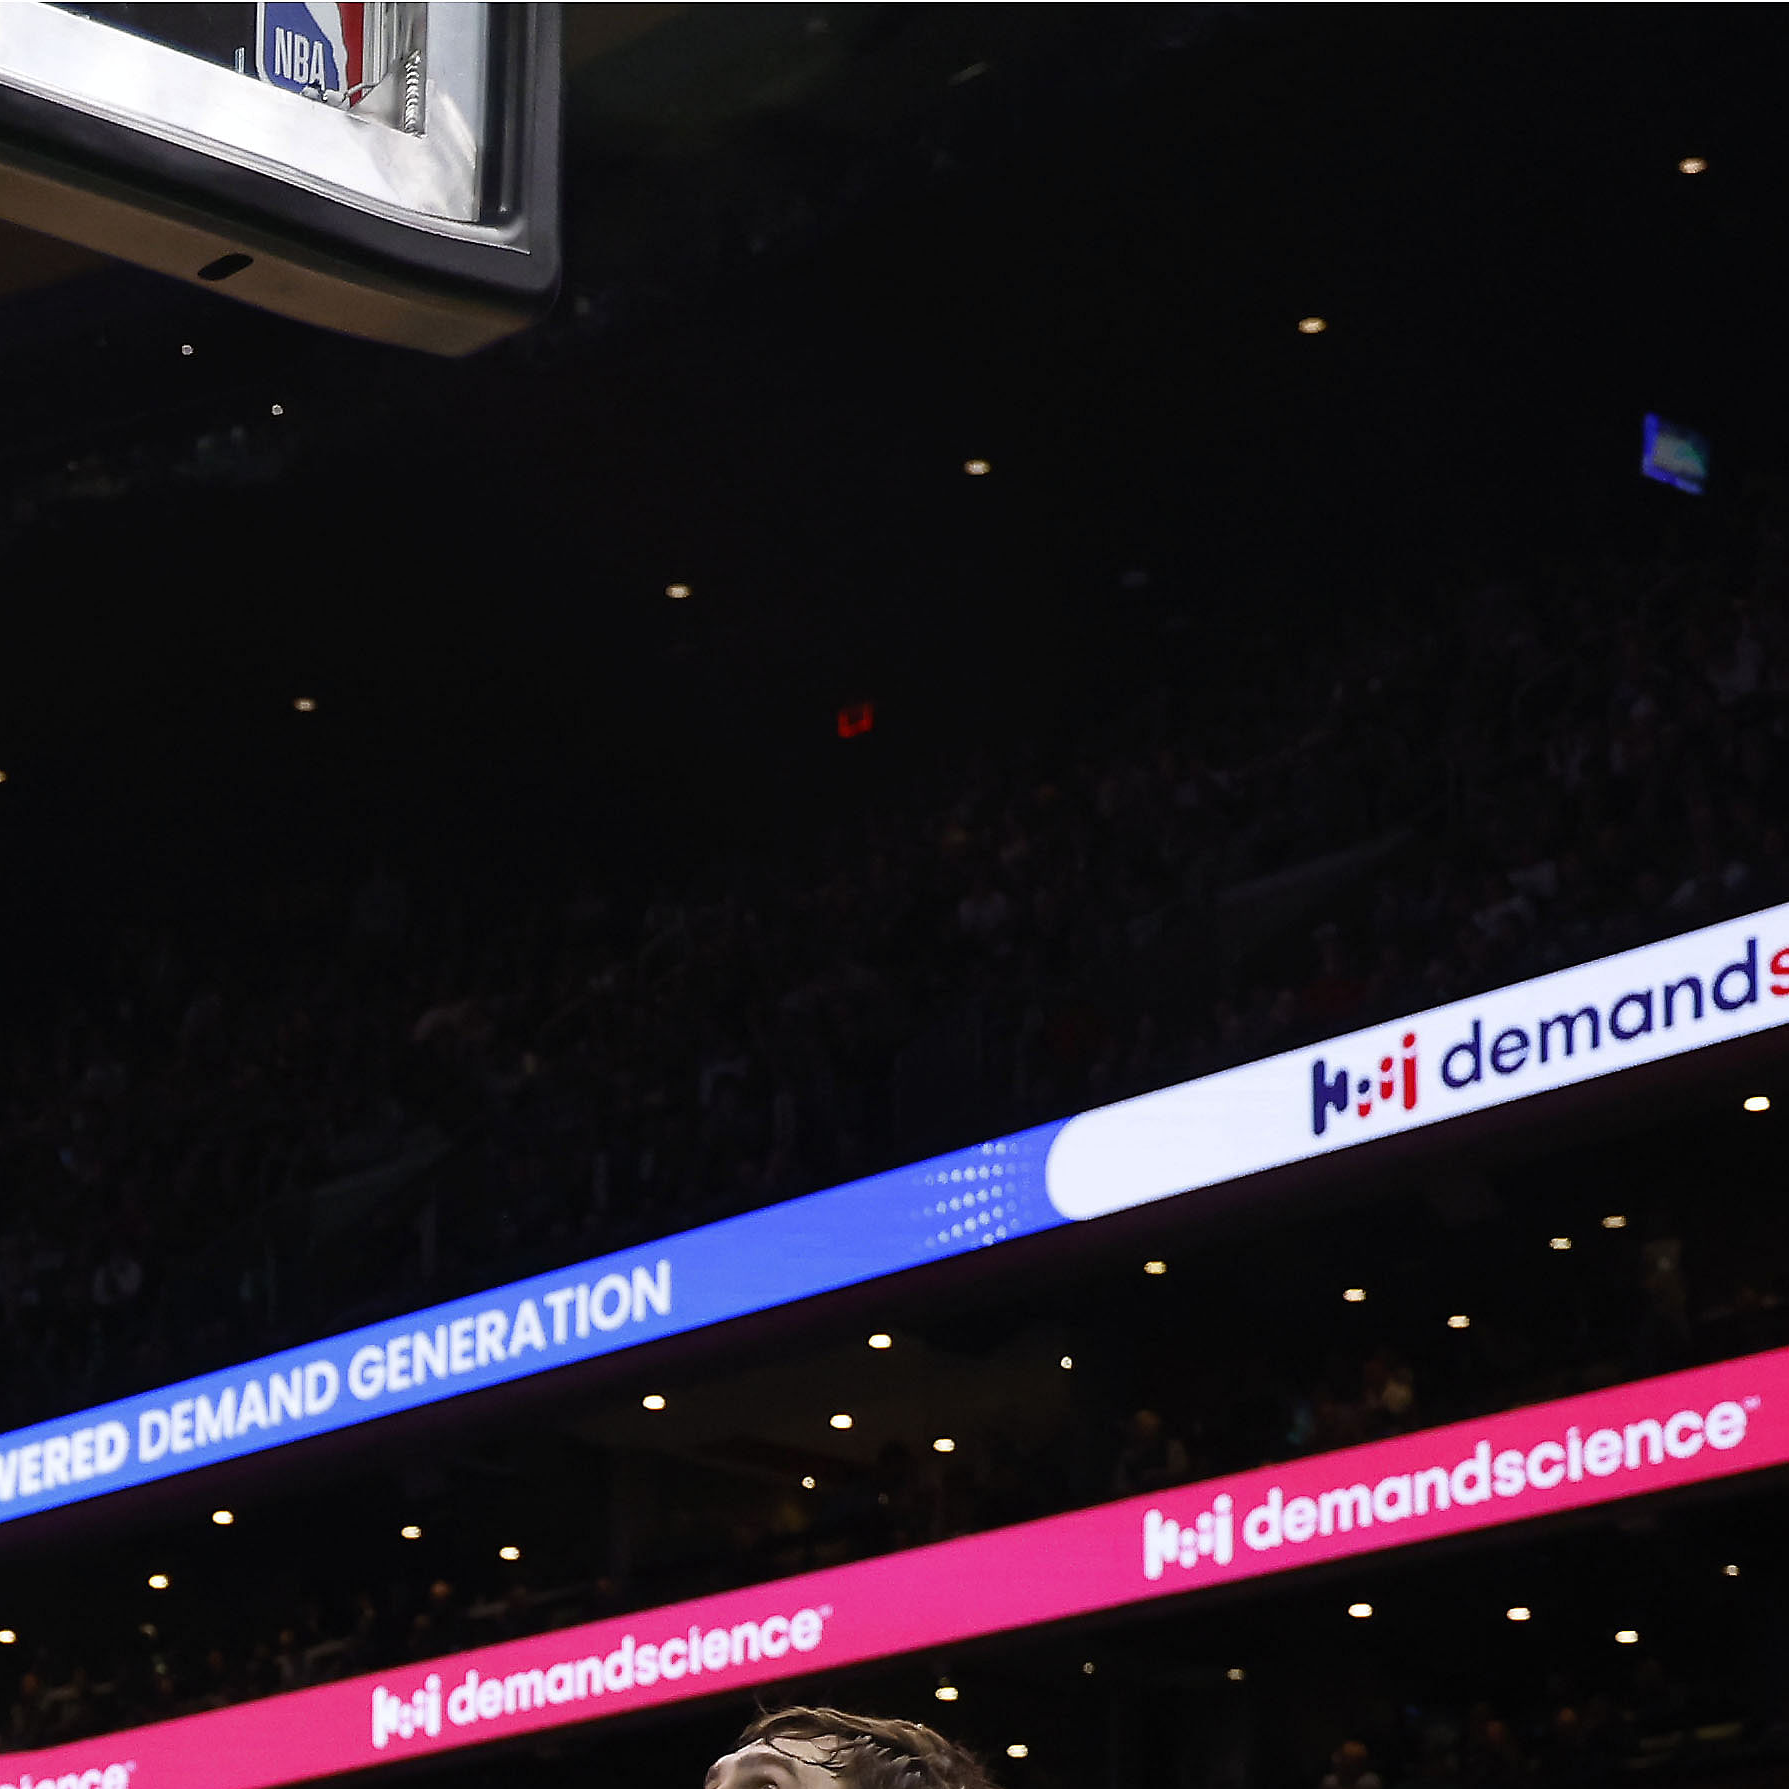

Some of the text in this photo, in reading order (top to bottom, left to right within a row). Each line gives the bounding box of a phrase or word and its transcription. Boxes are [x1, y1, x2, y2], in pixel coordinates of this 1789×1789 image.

[275, 26, 325, 91] NBA
[139, 1359, 339, 1463] DEMAND
[347, 1259, 672, 1400] GENERATION
[1242, 1399, 1747, 1551] demandscience
[447, 1607, 823, 1725] demandscience
